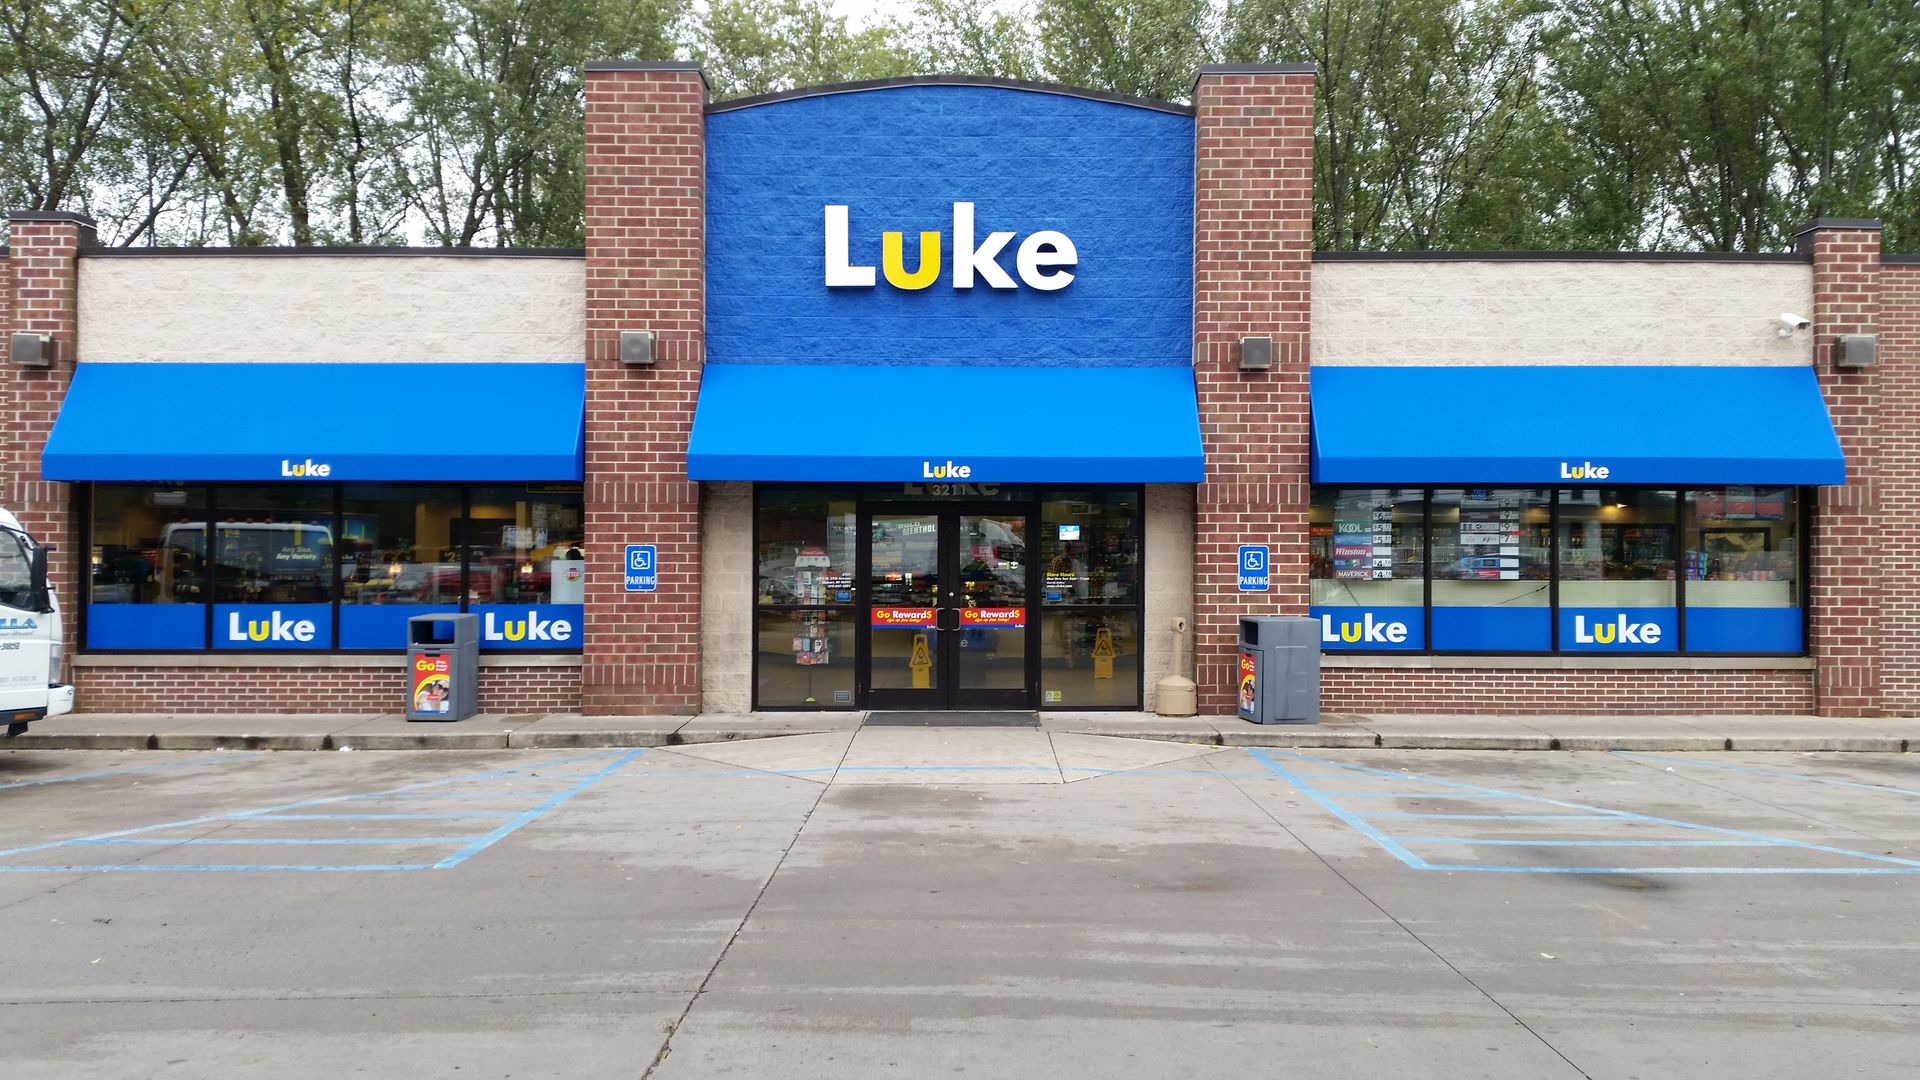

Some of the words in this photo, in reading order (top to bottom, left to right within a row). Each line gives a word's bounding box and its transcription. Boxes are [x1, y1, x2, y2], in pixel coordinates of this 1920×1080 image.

[824, 201, 1079, 291] Luke
[281, 459, 331, 477] Luke
[923, 460, 972, 478] Luke
[1560, 461, 1610, 479] Luke
[902, 524, 937, 536] MENTHOL
[1339, 523, 1363, 533] KOOL
[1335, 547, 1366, 555] Winston
[626, 575, 655, 585] PARKING
[1239, 576, 1268, 586] PARKING
[876, 610, 890, 618] Go
[892, 610, 933, 619] Reward$
[964, 610, 978, 618] Go
[980, 610, 1021, 619] Reward$
[230, 610, 316, 642] Luke
[485, 610, 572, 642] Luke
[1322, 612, 1408, 643] Luke
[1575, 613, 1662, 644] Luke
[416, 659, 436, 671] Go
